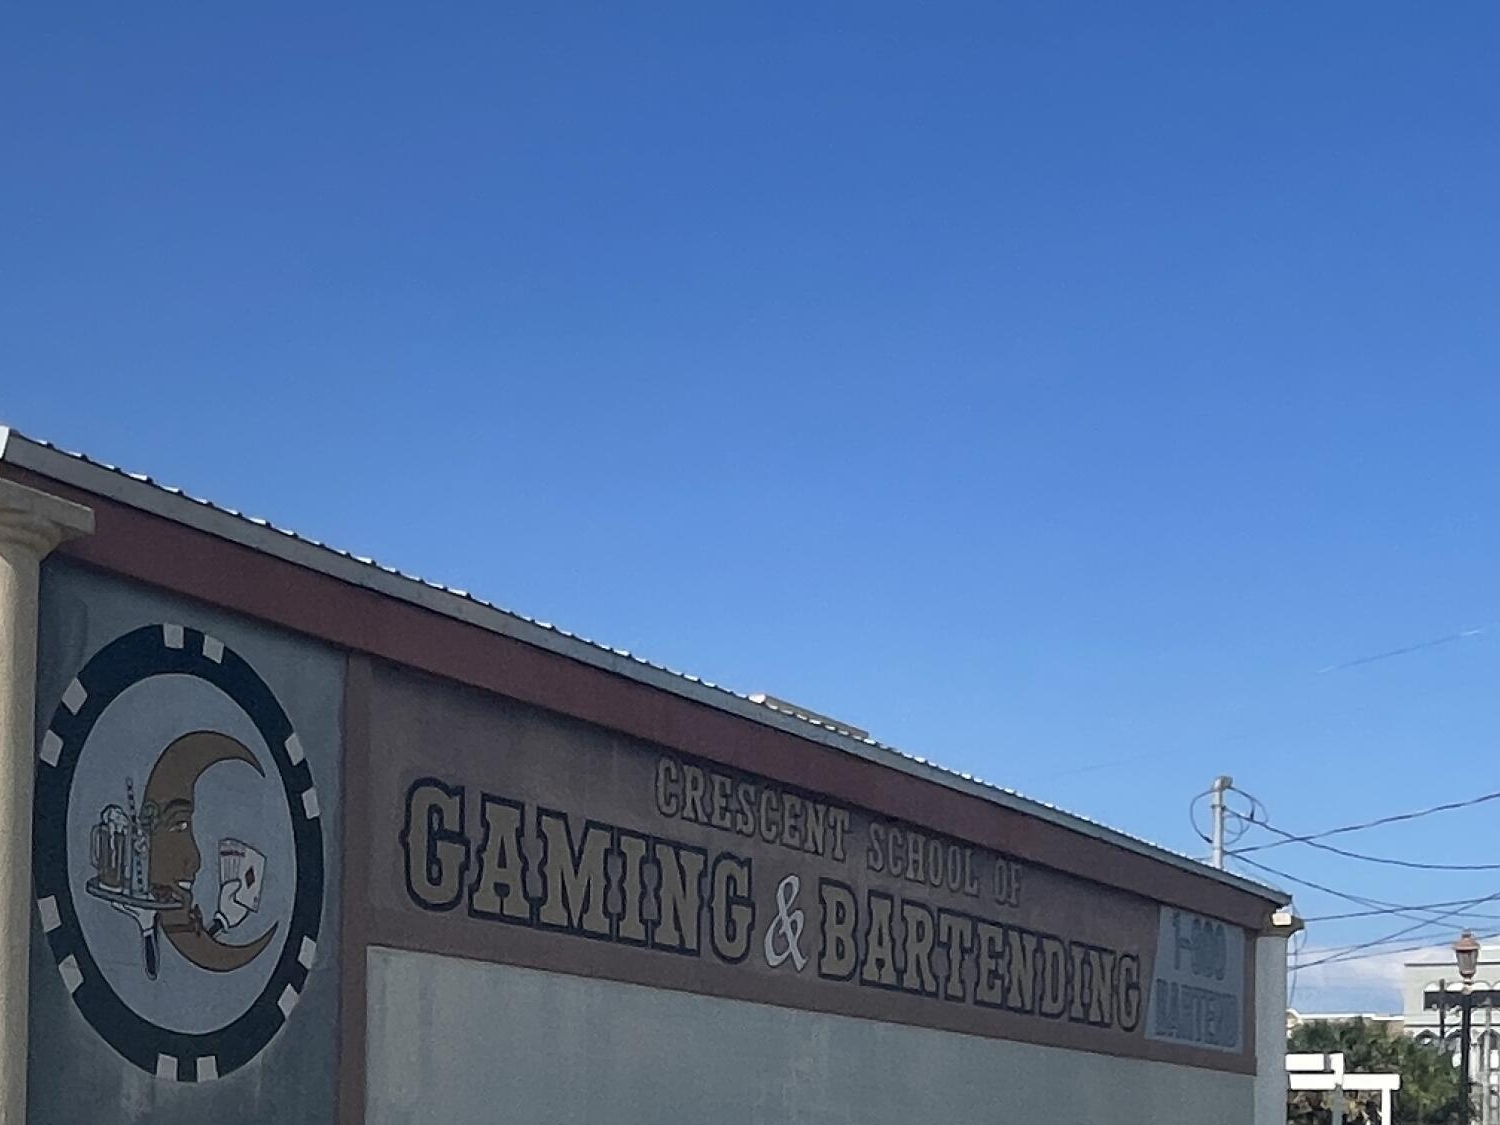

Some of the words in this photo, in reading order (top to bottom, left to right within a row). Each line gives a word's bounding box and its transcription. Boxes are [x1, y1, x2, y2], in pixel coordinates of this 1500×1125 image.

[400, 776, 756, 964] GAMING
[764, 874, 808, 973] &
[818, 877, 1143, 1031] BARTENDING
[655, 754, 850, 863] CRESCENT
[866, 821, 981, 898] SCHOOL
[994, 857, 1023, 908] OF
